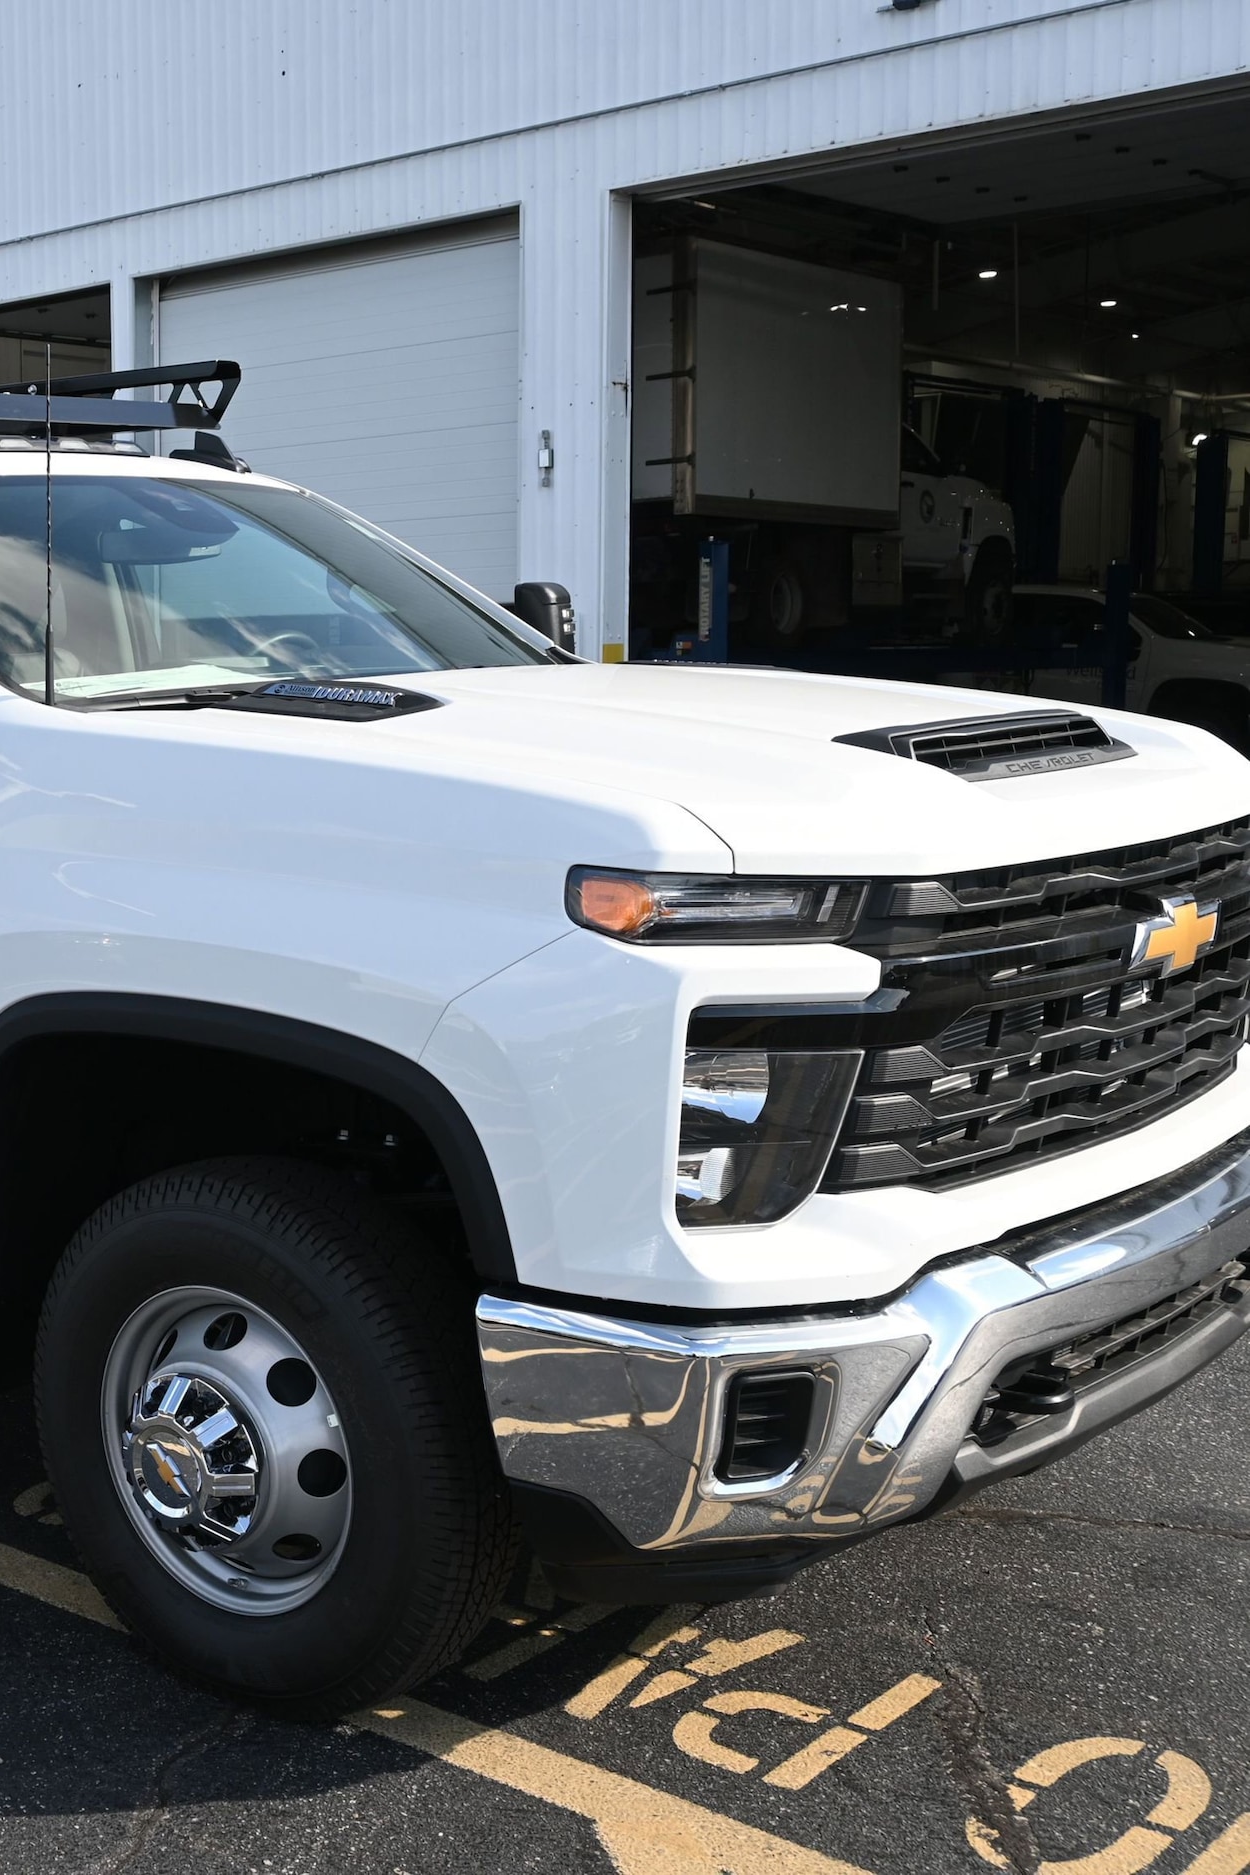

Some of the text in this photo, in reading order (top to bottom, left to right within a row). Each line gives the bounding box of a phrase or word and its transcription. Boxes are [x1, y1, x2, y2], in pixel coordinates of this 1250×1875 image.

[700, 557, 710, 635] ROTARY LIFT
[285, 683, 316, 693] Allison
[313, 686, 404, 706] DURAMAX
[1005, 752, 1095, 773] CHEVROLET
